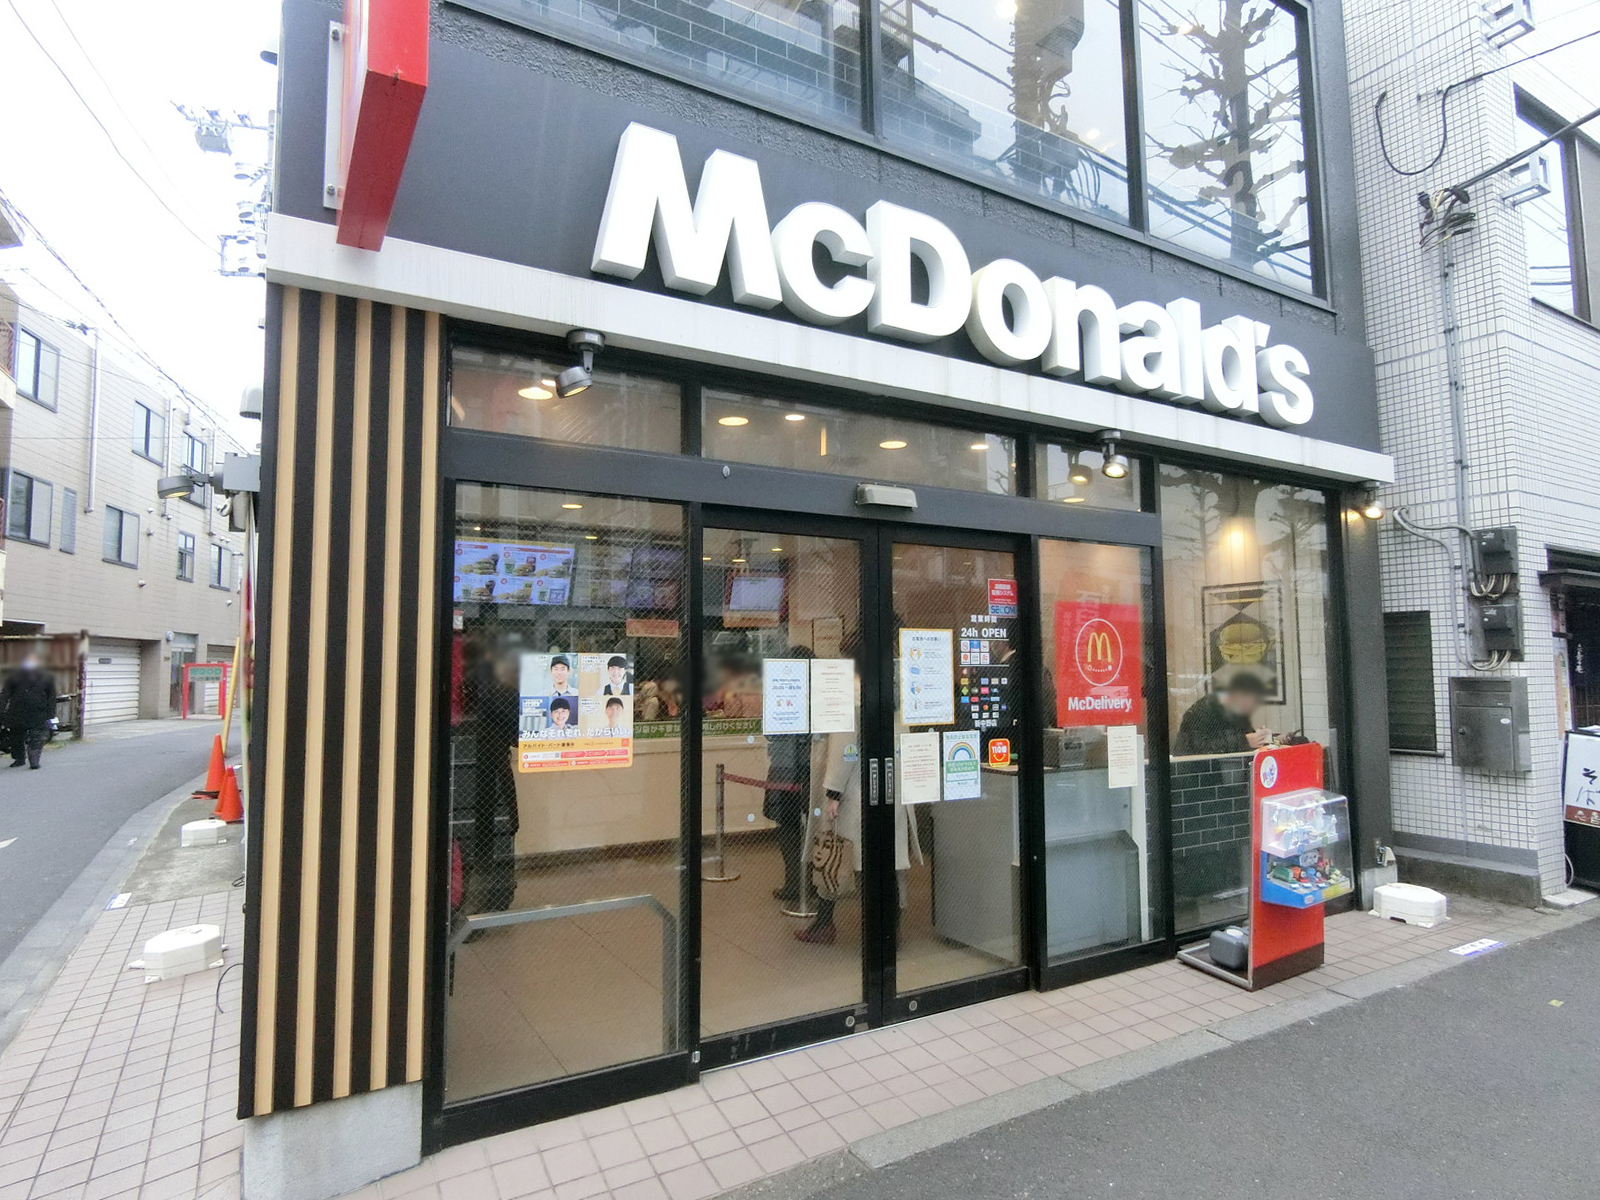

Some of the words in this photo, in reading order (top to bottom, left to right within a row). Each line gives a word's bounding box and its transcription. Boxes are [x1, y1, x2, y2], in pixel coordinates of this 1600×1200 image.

[592, 121, 1315, 427] McDonald's
[991, 605, 1016, 614] SECOM
[961, 627, 979, 638] 24h
[981, 628, 1007, 638] OPEN
[1068, 695, 1132, 713] McDelivery
